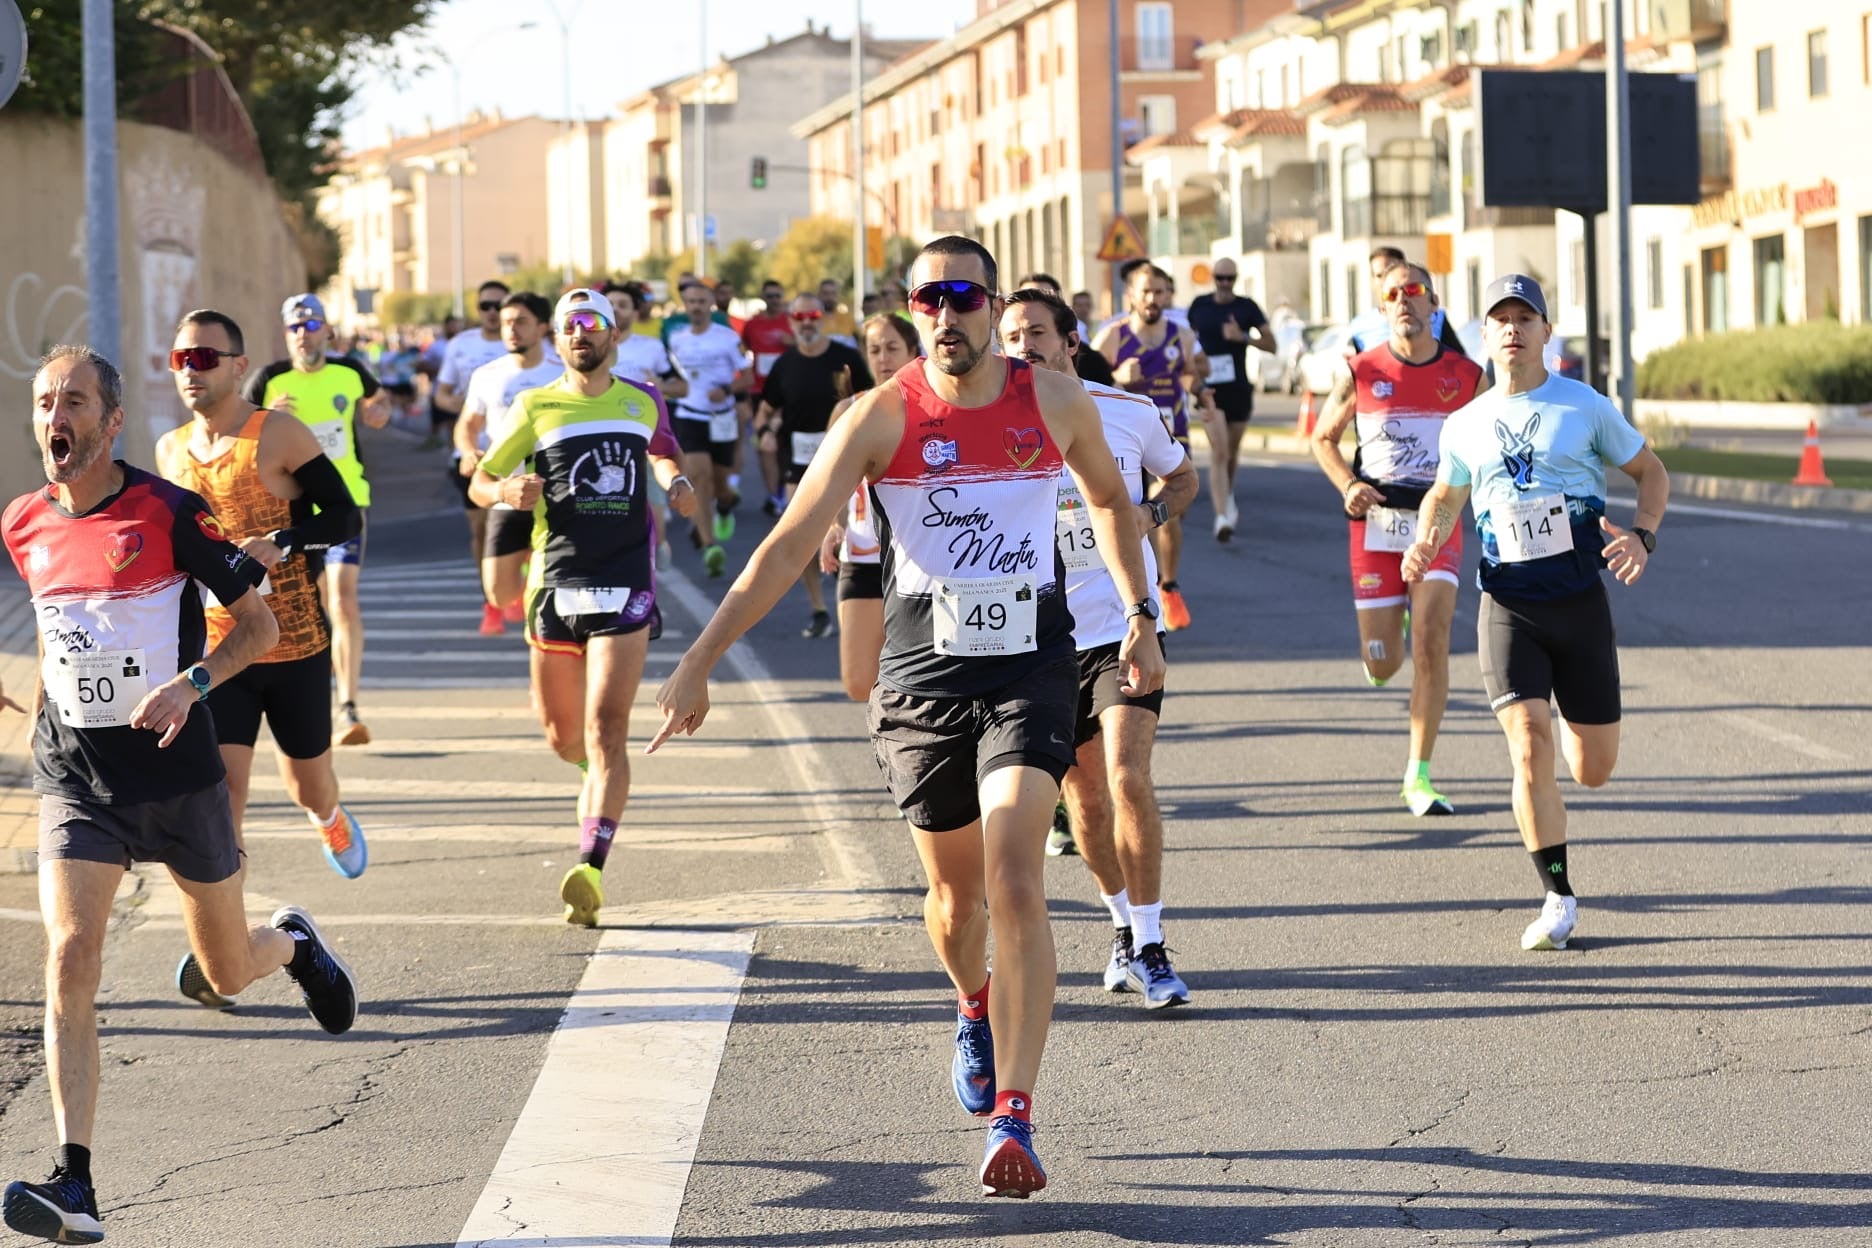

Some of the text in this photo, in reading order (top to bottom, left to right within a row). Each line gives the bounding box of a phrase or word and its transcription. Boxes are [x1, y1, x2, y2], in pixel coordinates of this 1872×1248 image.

[922, 487, 994, 532] Simón
[1386, 519, 1410, 537] 46
[1508, 516, 1554, 542] 114
[948, 529, 1039, 574] Martín
[965, 603, 1007, 631] 49
[78, 676, 115, 704] 50
